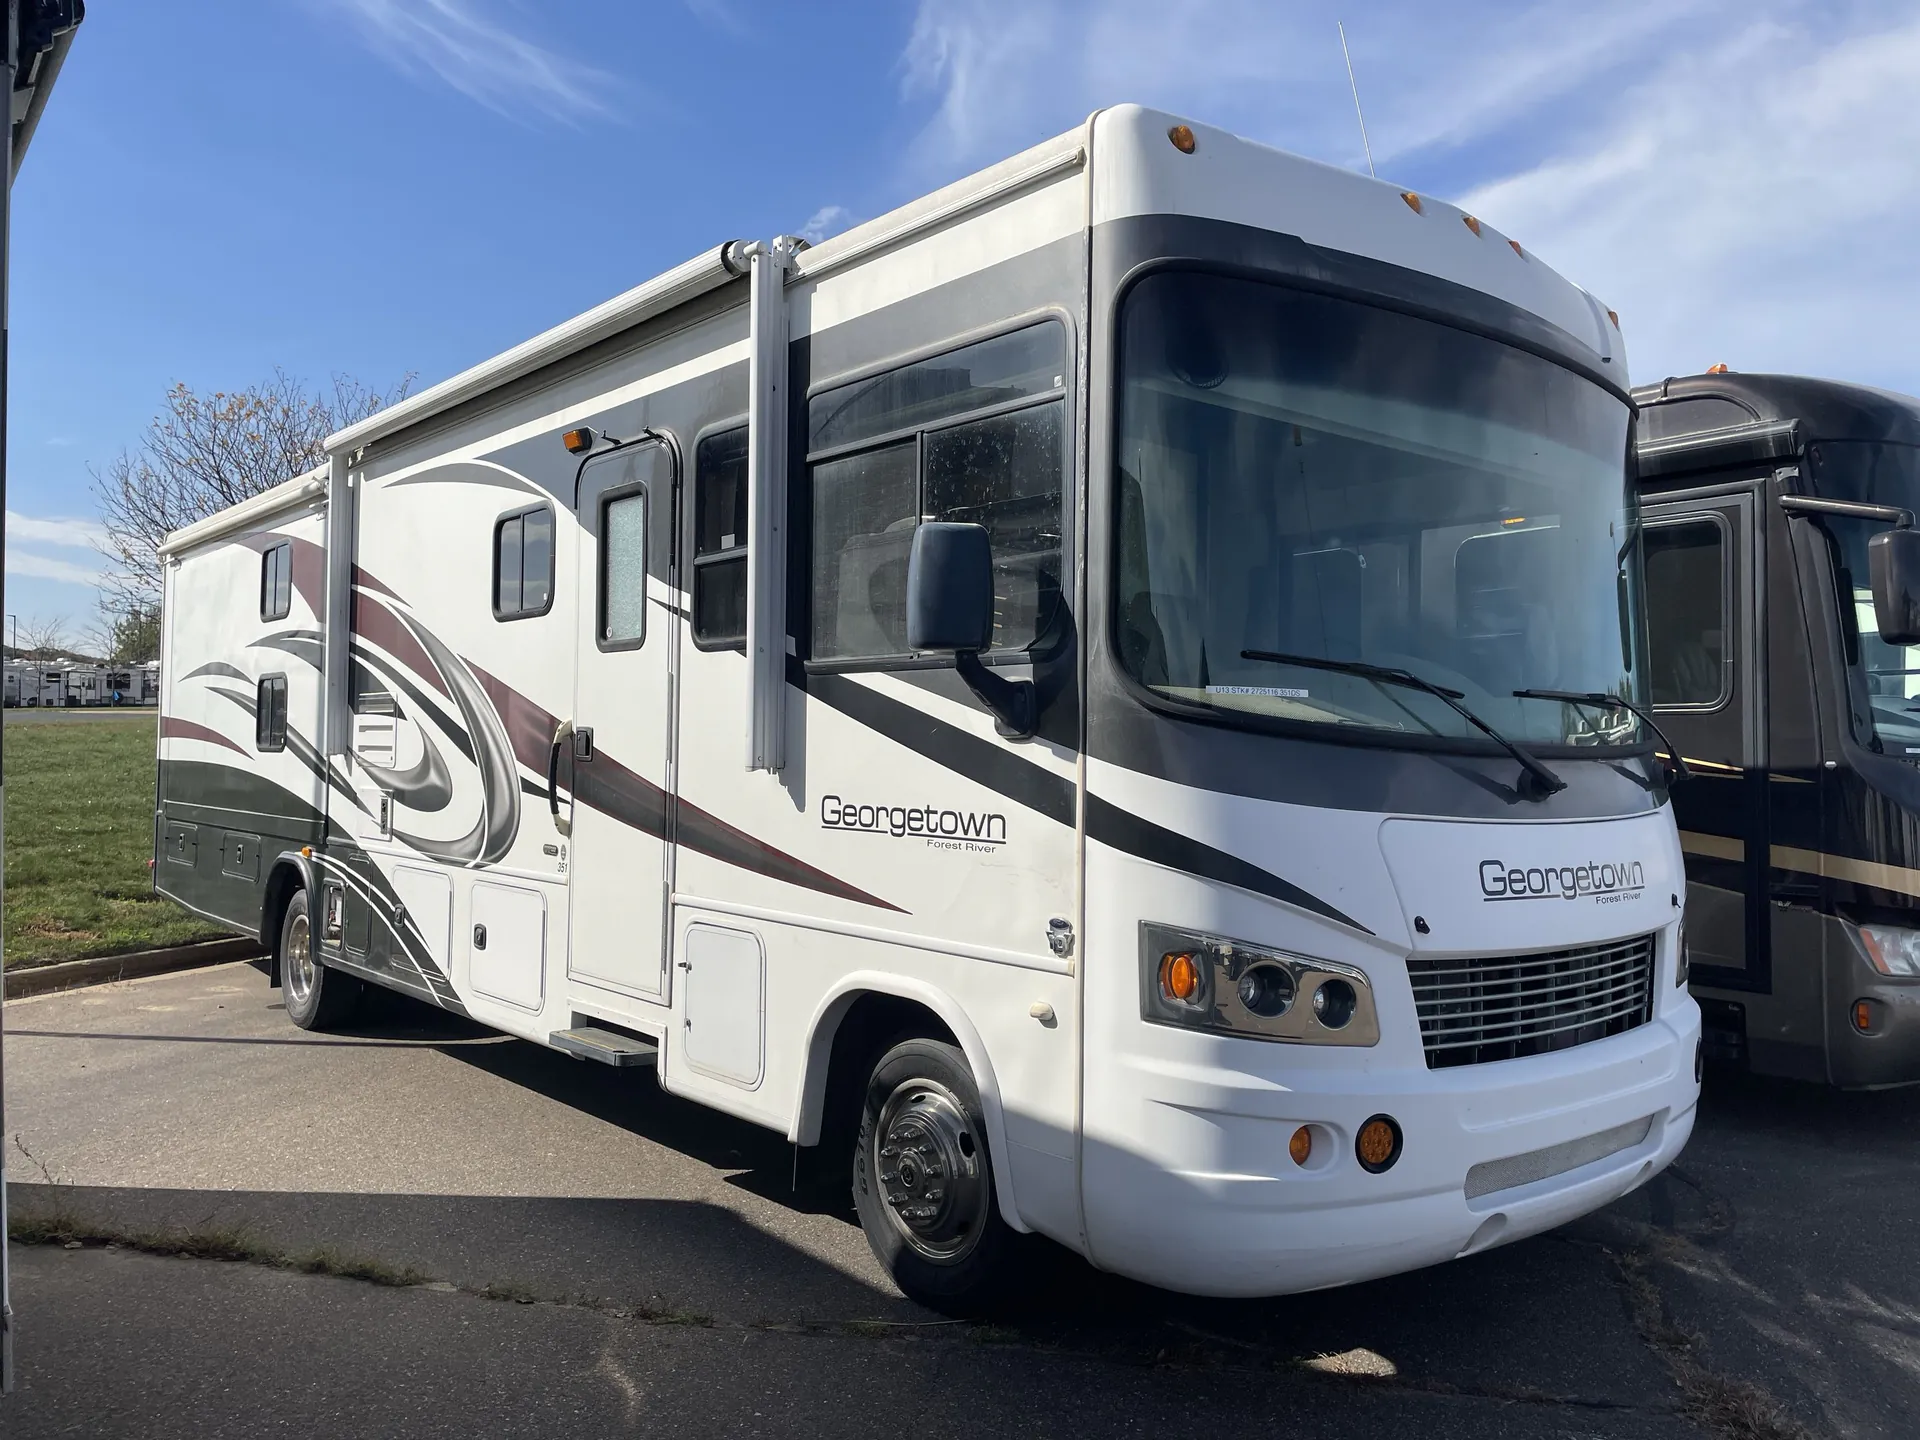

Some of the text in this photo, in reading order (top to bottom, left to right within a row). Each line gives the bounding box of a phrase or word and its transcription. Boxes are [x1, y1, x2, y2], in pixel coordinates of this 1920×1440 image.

[1215, 686, 1230, 694] U13
[1231, 686, 1249, 695] STK#
[821, 794, 1007, 840] Georgetown
[926, 839, 996, 853] Forest River
[557, 861, 568, 873] 351
[1479, 859, 1645, 901] Georgetown
[1595, 892, 1641, 905] Forest River
